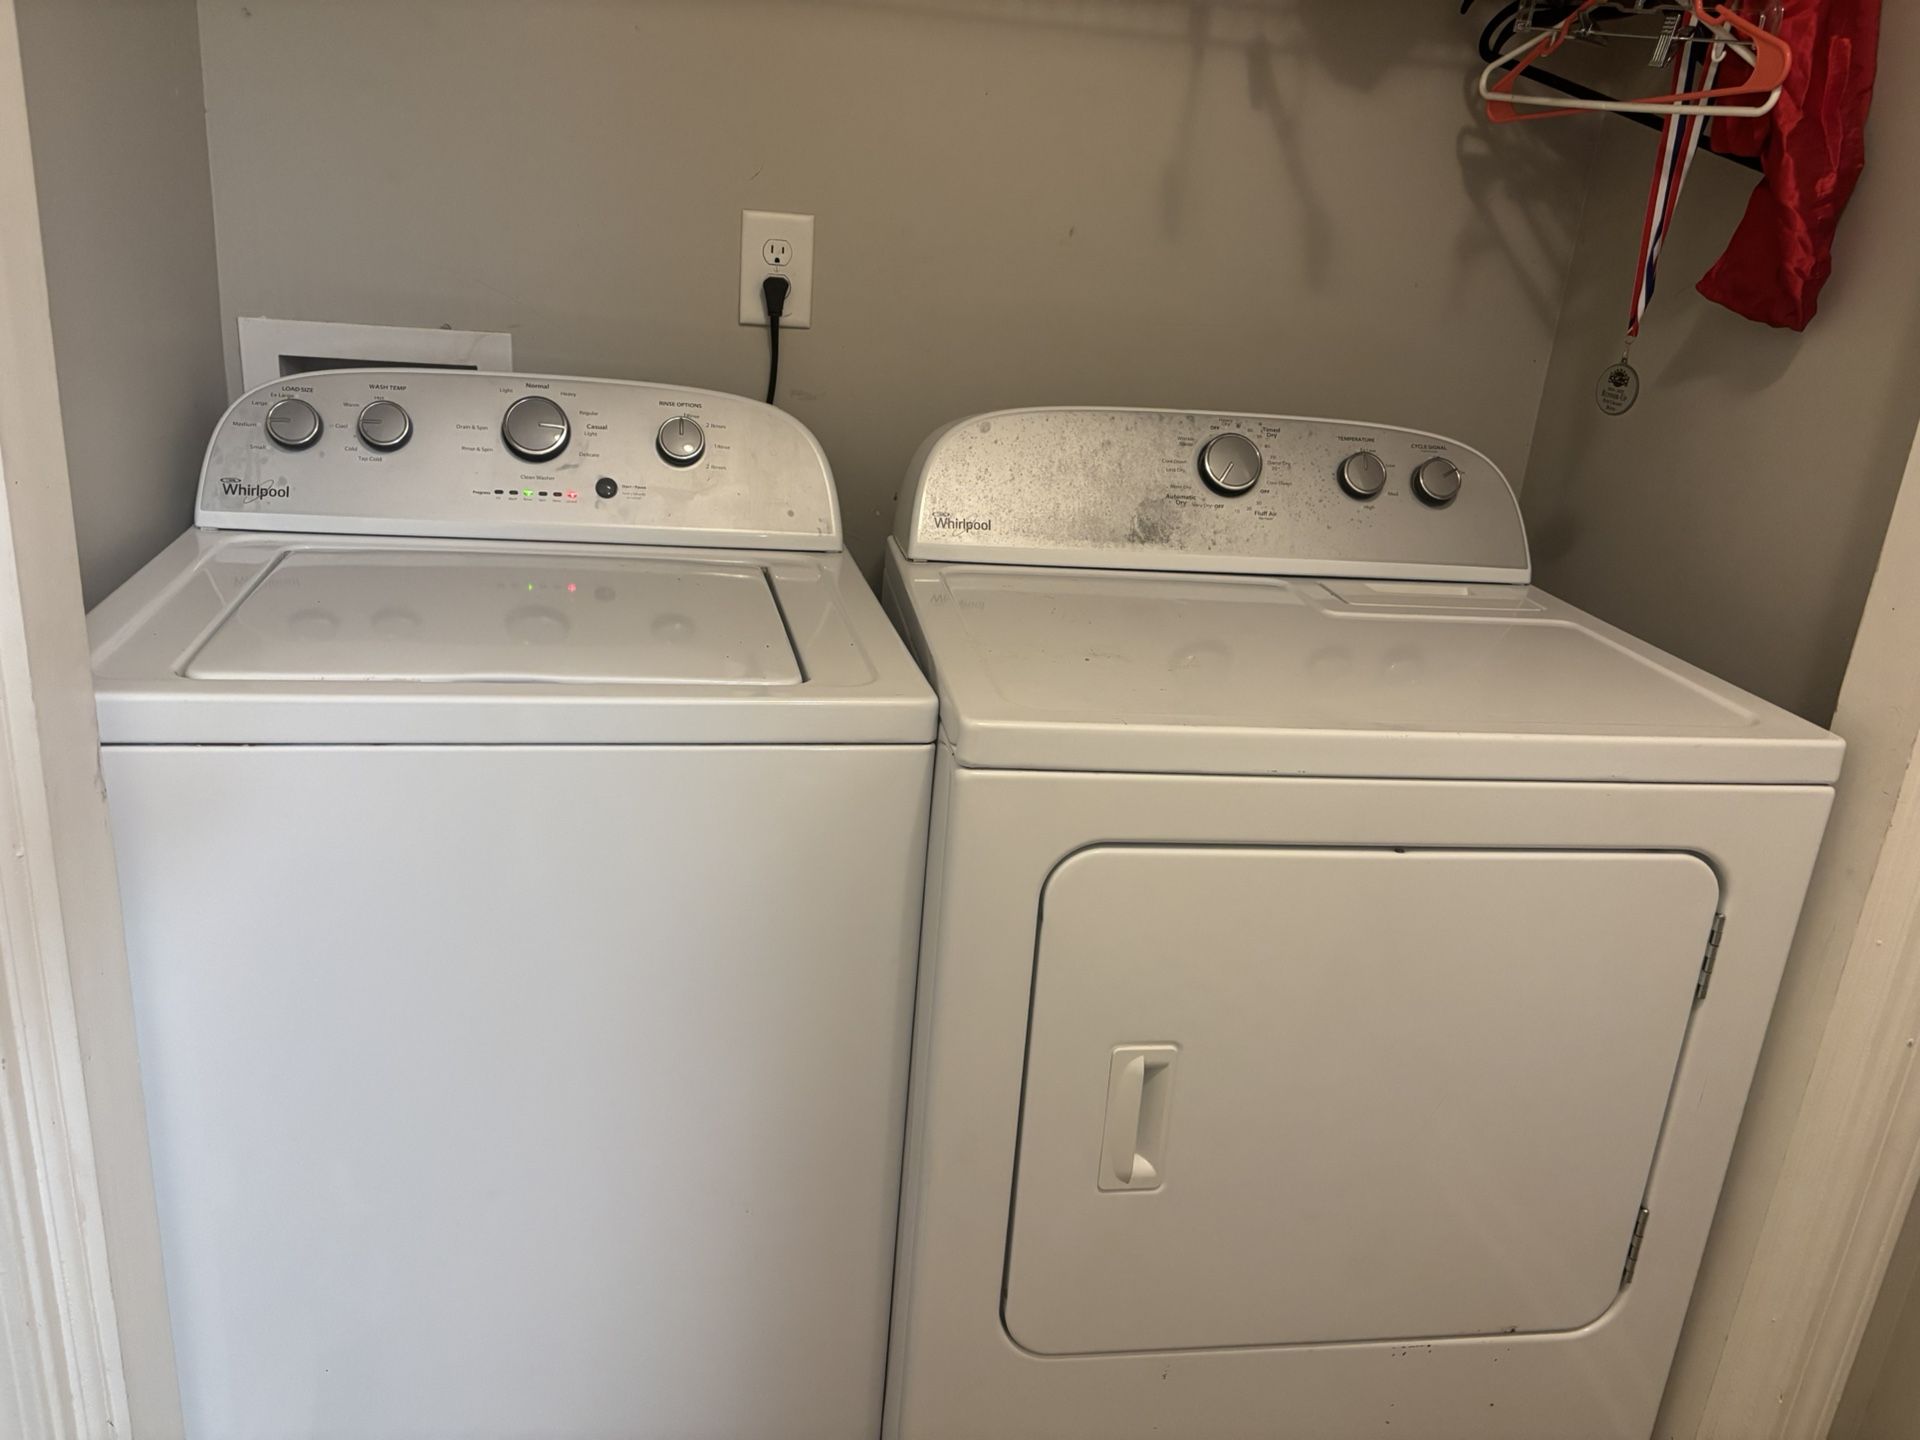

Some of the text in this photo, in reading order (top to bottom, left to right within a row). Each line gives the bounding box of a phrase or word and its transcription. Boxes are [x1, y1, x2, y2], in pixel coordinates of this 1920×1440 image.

[525, 382, 550, 390] Normal
[222, 482, 290, 501] Whirlpool
[933, 517, 992, 533] Whirlpool
